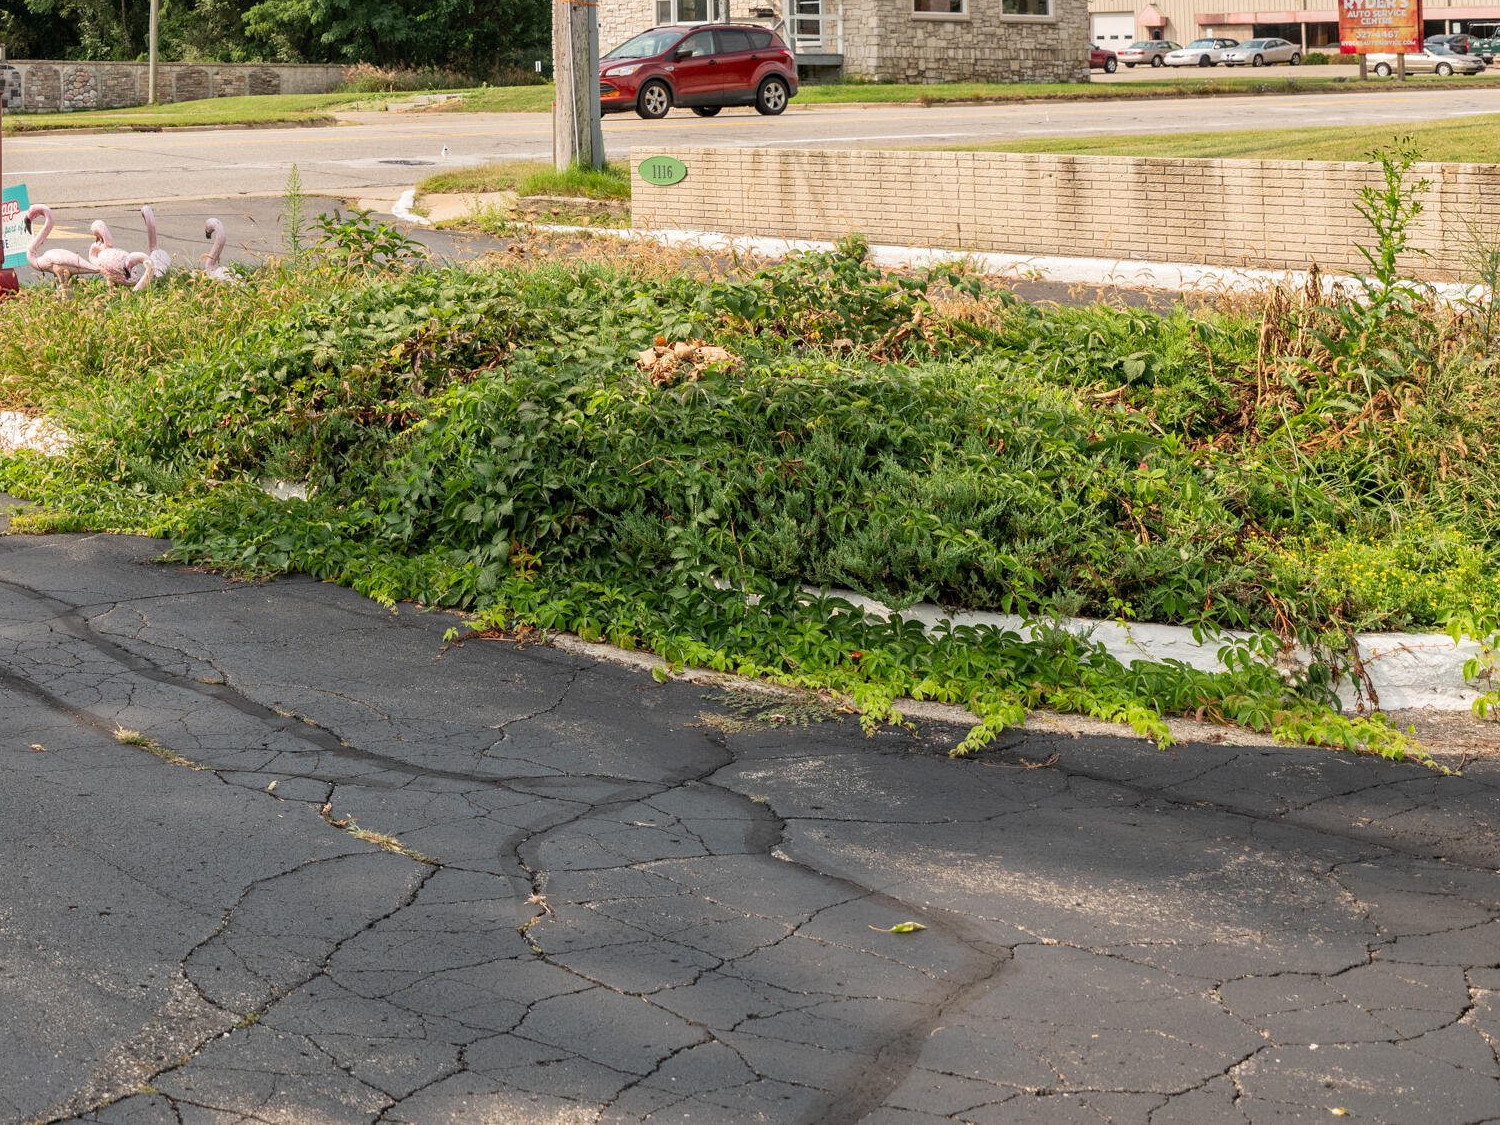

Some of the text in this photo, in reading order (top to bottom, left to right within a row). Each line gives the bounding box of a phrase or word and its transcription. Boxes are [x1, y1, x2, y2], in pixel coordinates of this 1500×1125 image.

[1347, 9, 1407, 19] AUTO SERVICE
[1360, 17, 1394, 25] CENTRE
[652, 164, 673, 180] 1116
